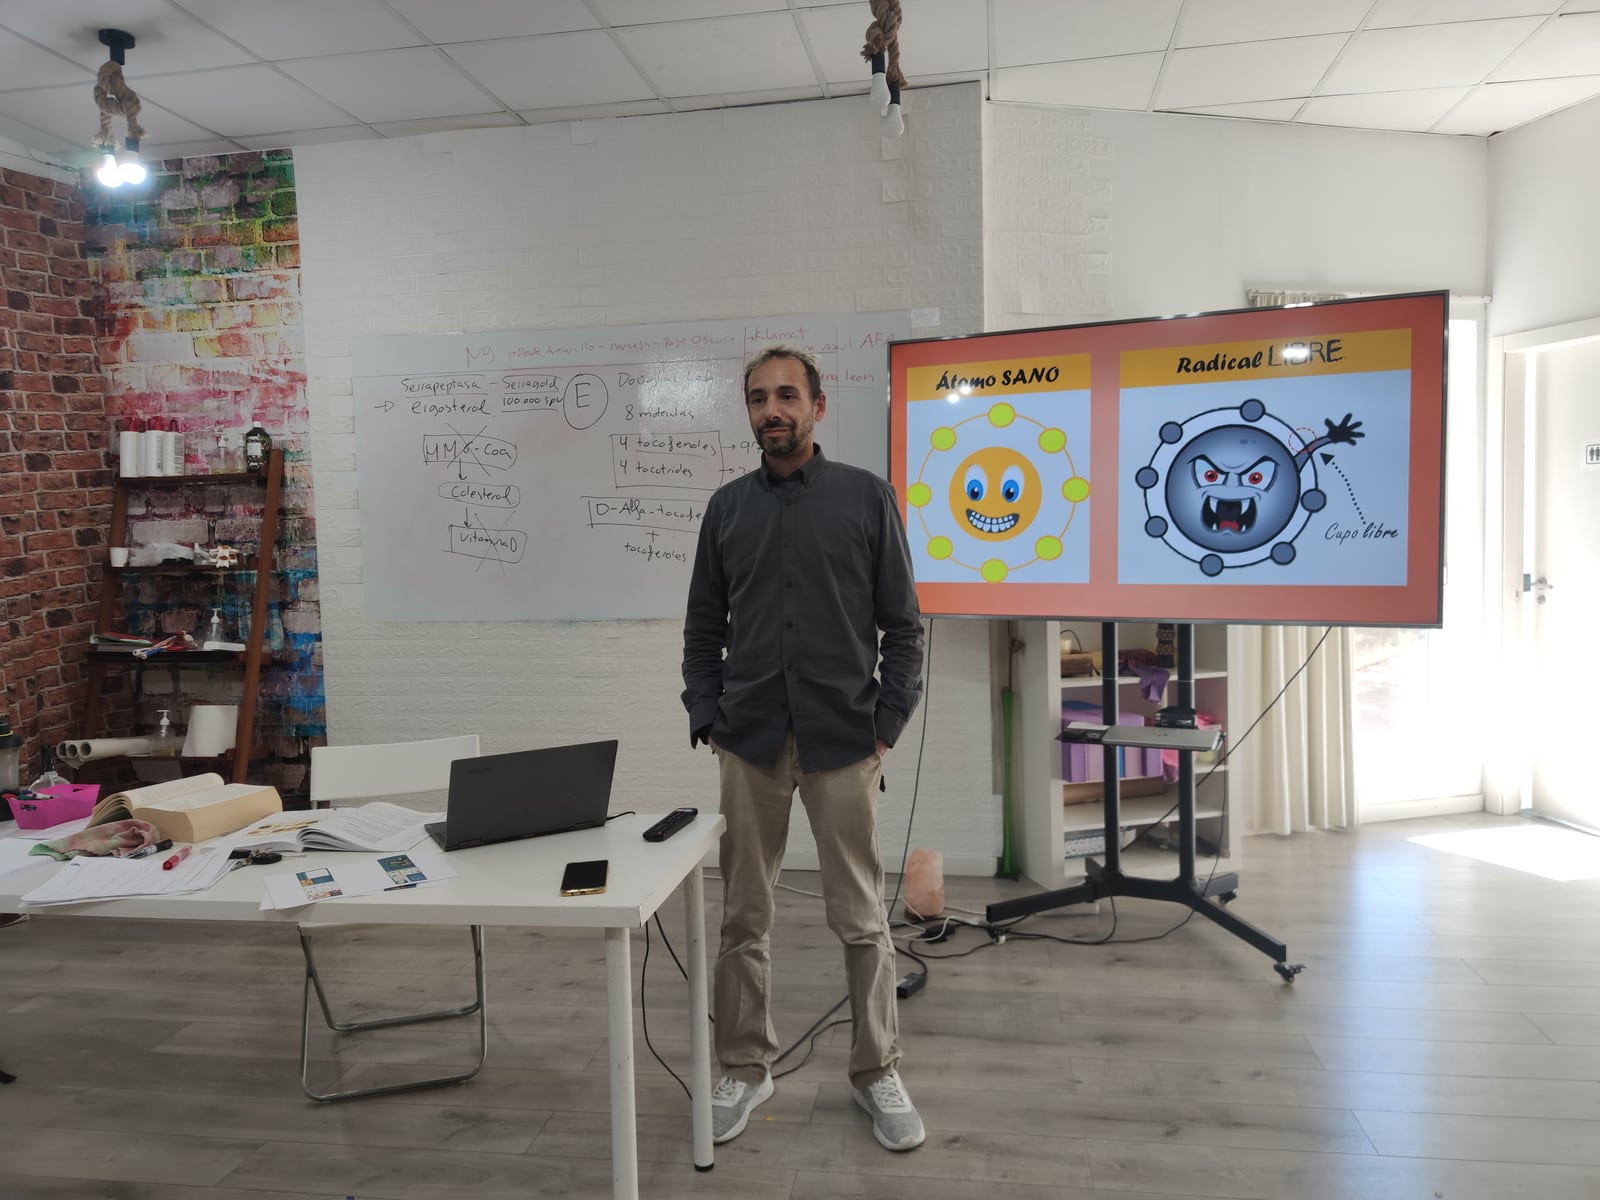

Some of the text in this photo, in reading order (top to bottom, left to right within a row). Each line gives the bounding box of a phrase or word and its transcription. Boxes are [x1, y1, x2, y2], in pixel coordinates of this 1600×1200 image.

[1176, 339, 1345, 374] Radical LIBRE
[936, 366, 1060, 391] Átomo SANO
[619, 436, 628, 450] 4
[619, 460, 628, 475] 4
[1324, 522, 1399, 546] Cupo libre
